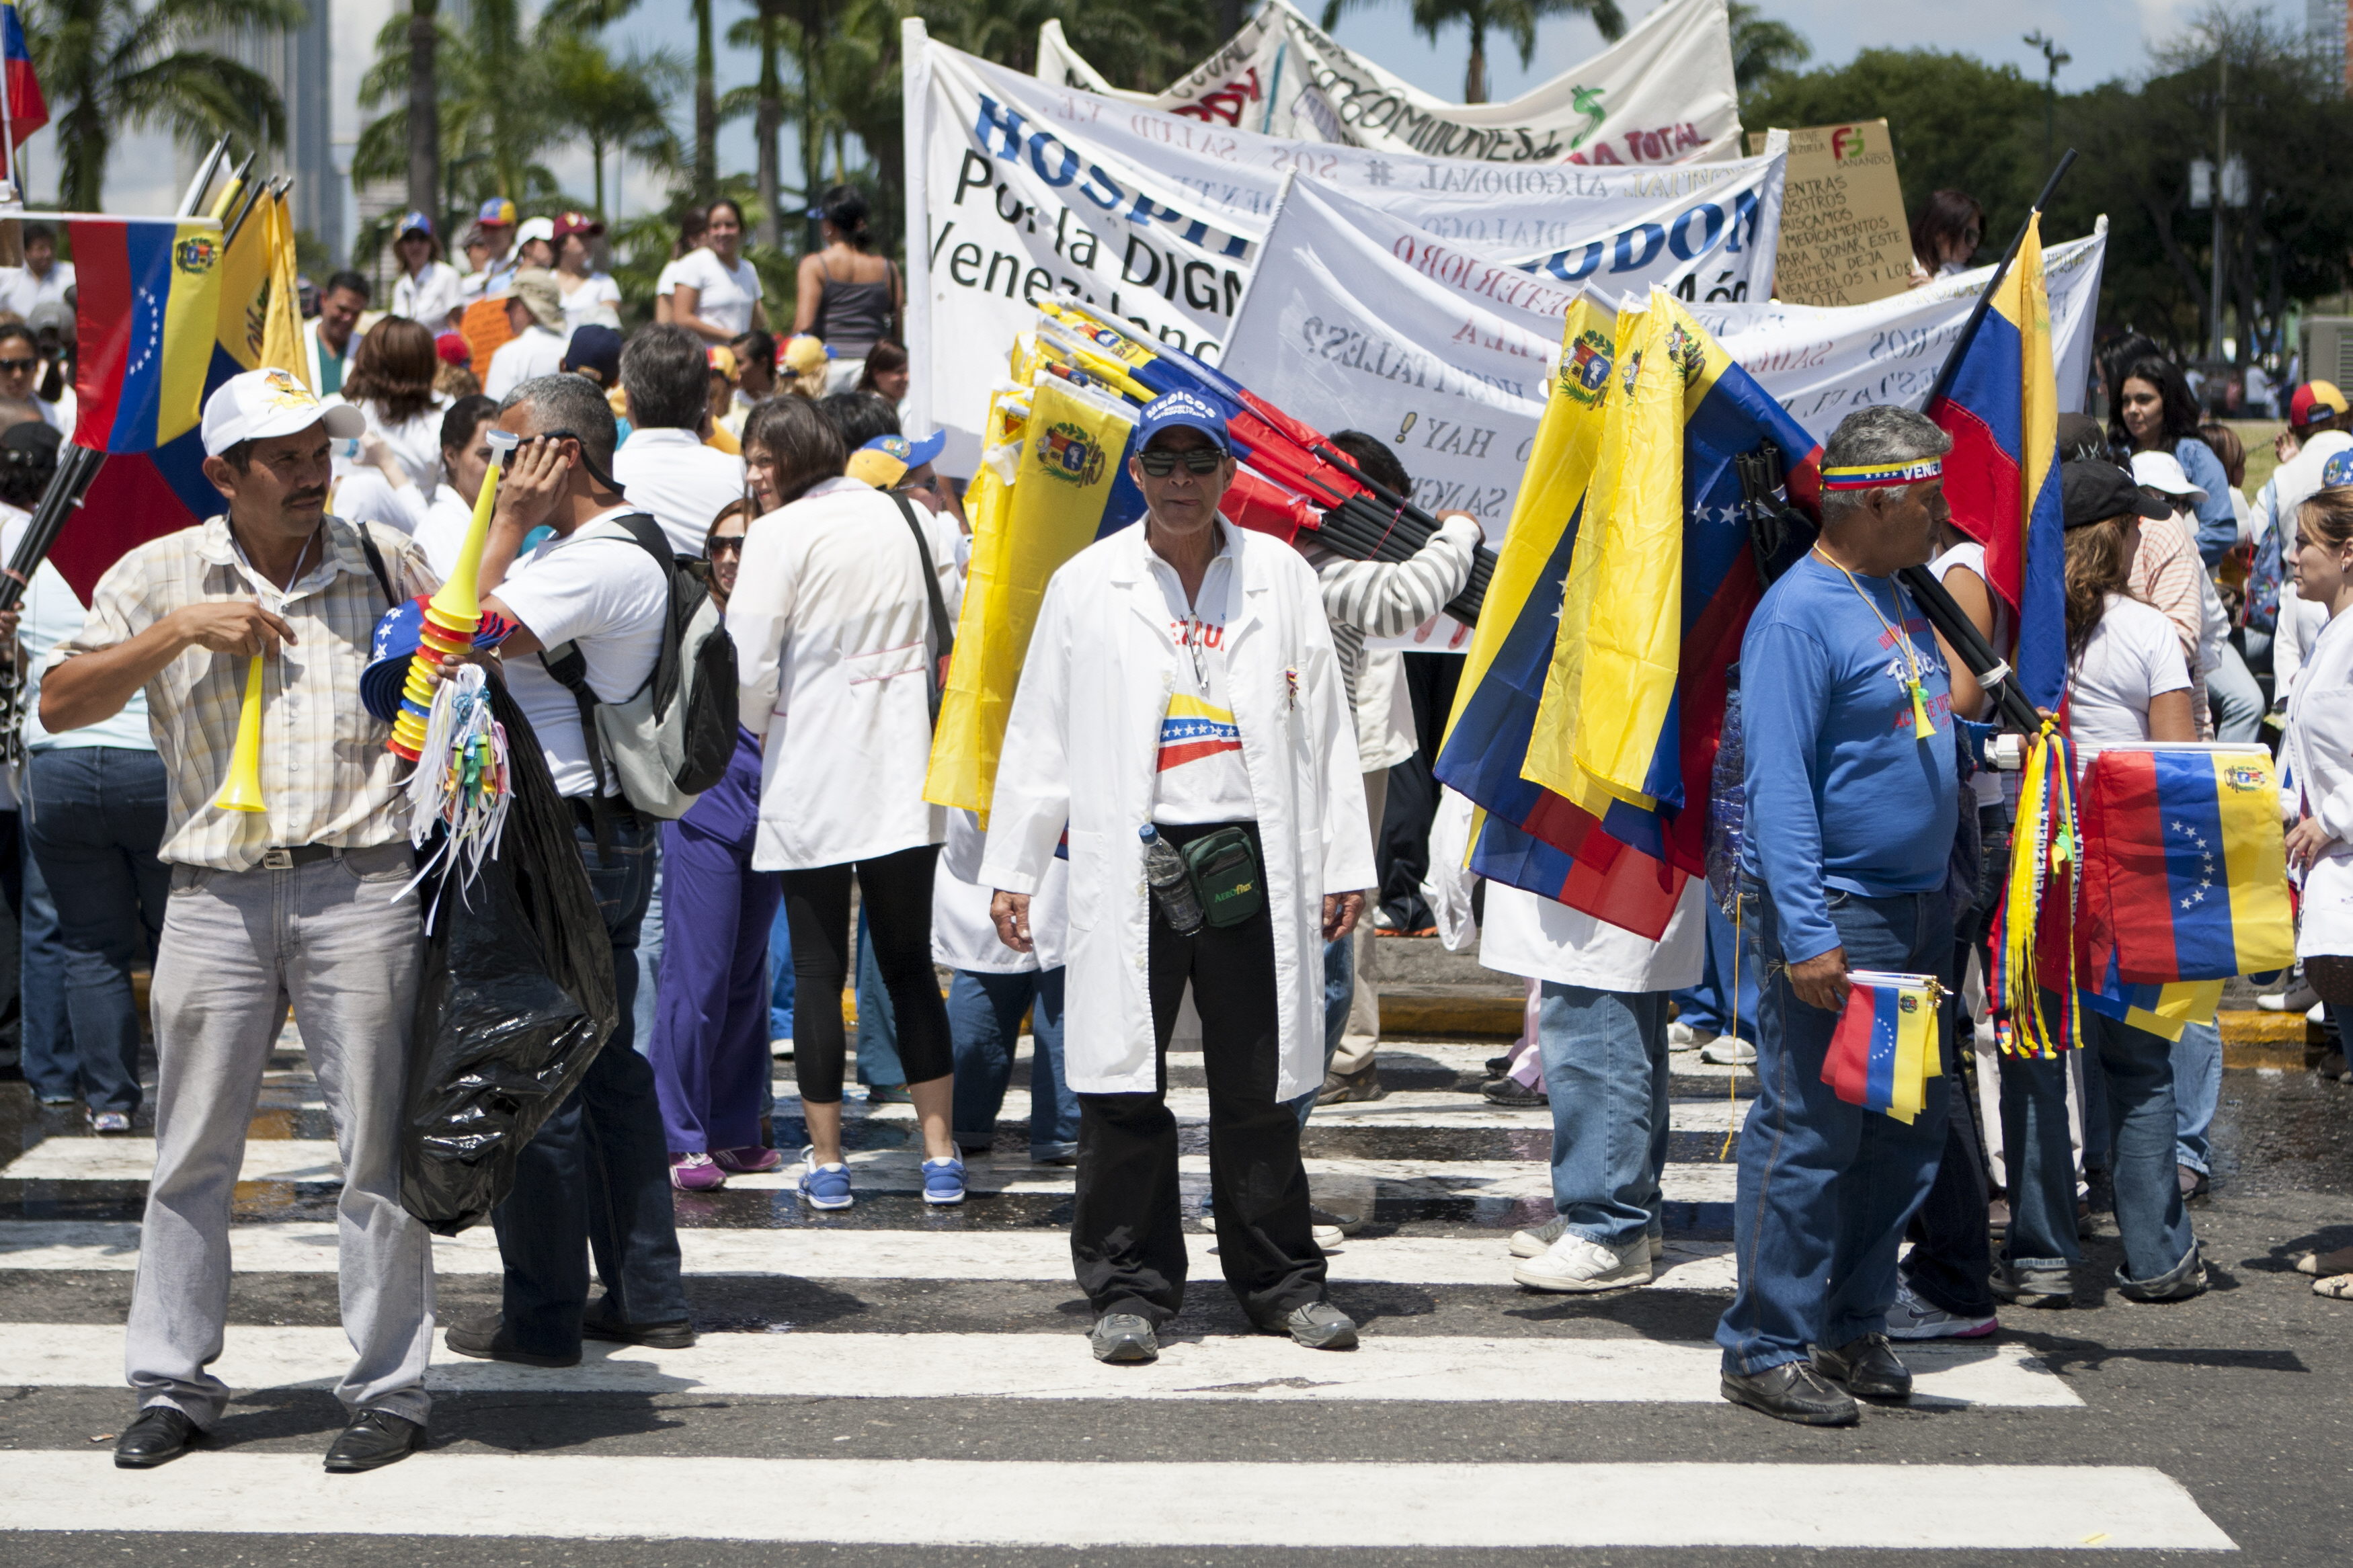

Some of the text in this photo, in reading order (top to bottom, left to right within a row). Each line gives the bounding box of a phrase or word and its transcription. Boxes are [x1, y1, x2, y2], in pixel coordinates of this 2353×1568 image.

[1624, 121, 1712, 163] TOTAL
[1836, 153, 1892, 169] SANANDO
[1780, 208, 1853, 233] BUSCAMOS
[1782, 192, 1847, 216] OSOTROS
[1053, 206, 1099, 270] la
[1776, 251, 1811, 269] PARA
[1869, 230, 1903, 249] ESTE
[1786, 216, 1890, 249] MEDICAMENTOS
[1778, 250, 1885, 284] REGIMEN DEJA
[1782, 271, 1864, 296] VENCERLOS
[1871, 269, 1879, 284] Y
[1886, 262, 1913, 280] LOS
[2032, 811, 2050, 901] VENEZUELA
